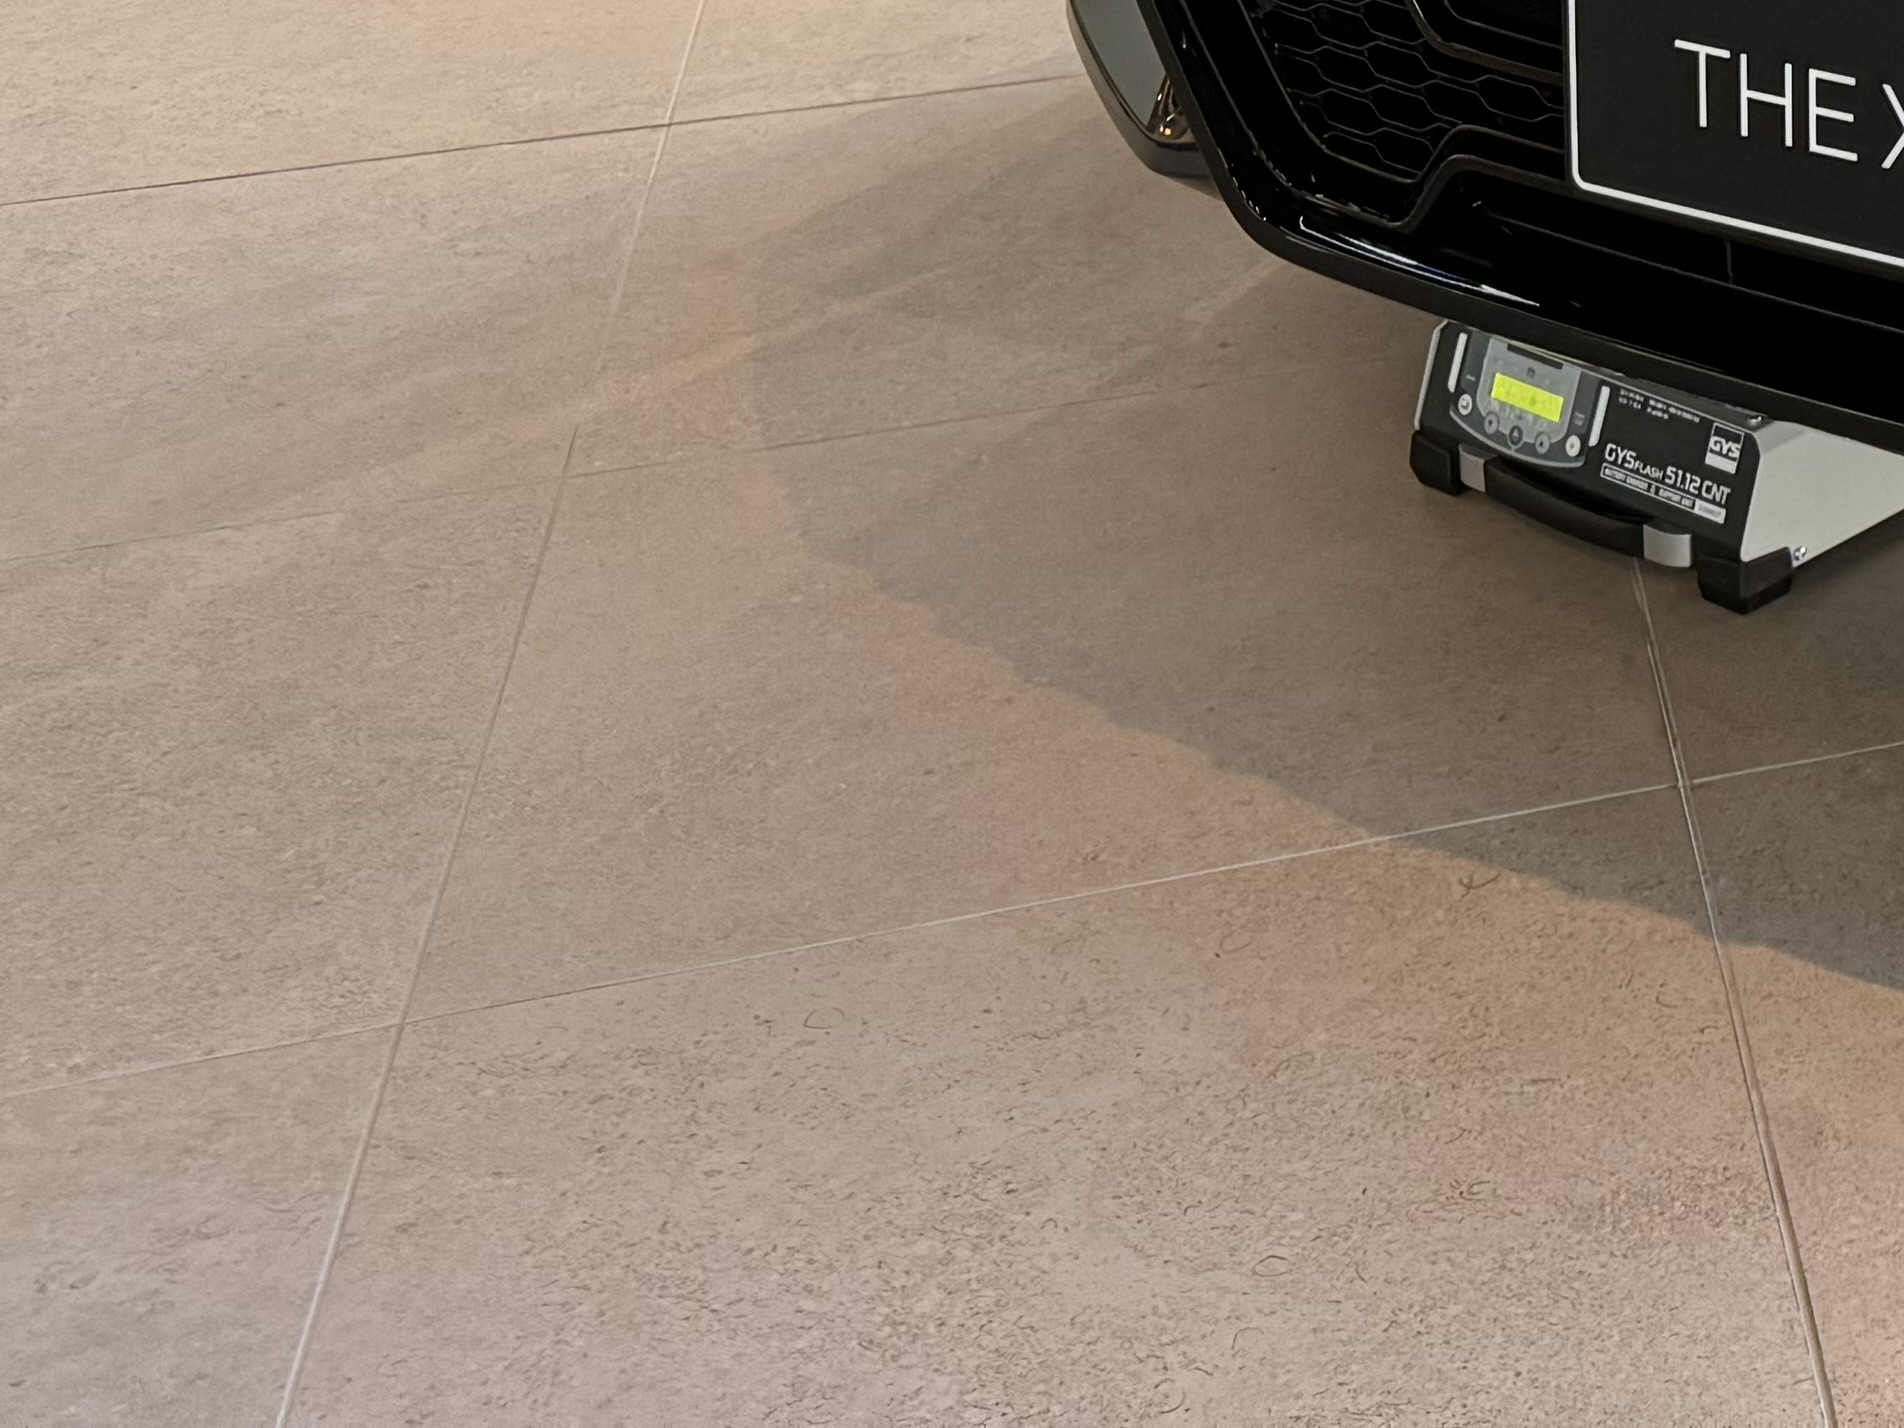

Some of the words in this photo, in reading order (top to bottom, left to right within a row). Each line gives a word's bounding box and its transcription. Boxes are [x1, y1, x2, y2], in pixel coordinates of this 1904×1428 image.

[1673, 38, 1859, 163] THE
[1709, 435, 1742, 459] GYS
[1664, 465, 1702, 496] 51.12
[1701, 480, 1732, 506] CNT
